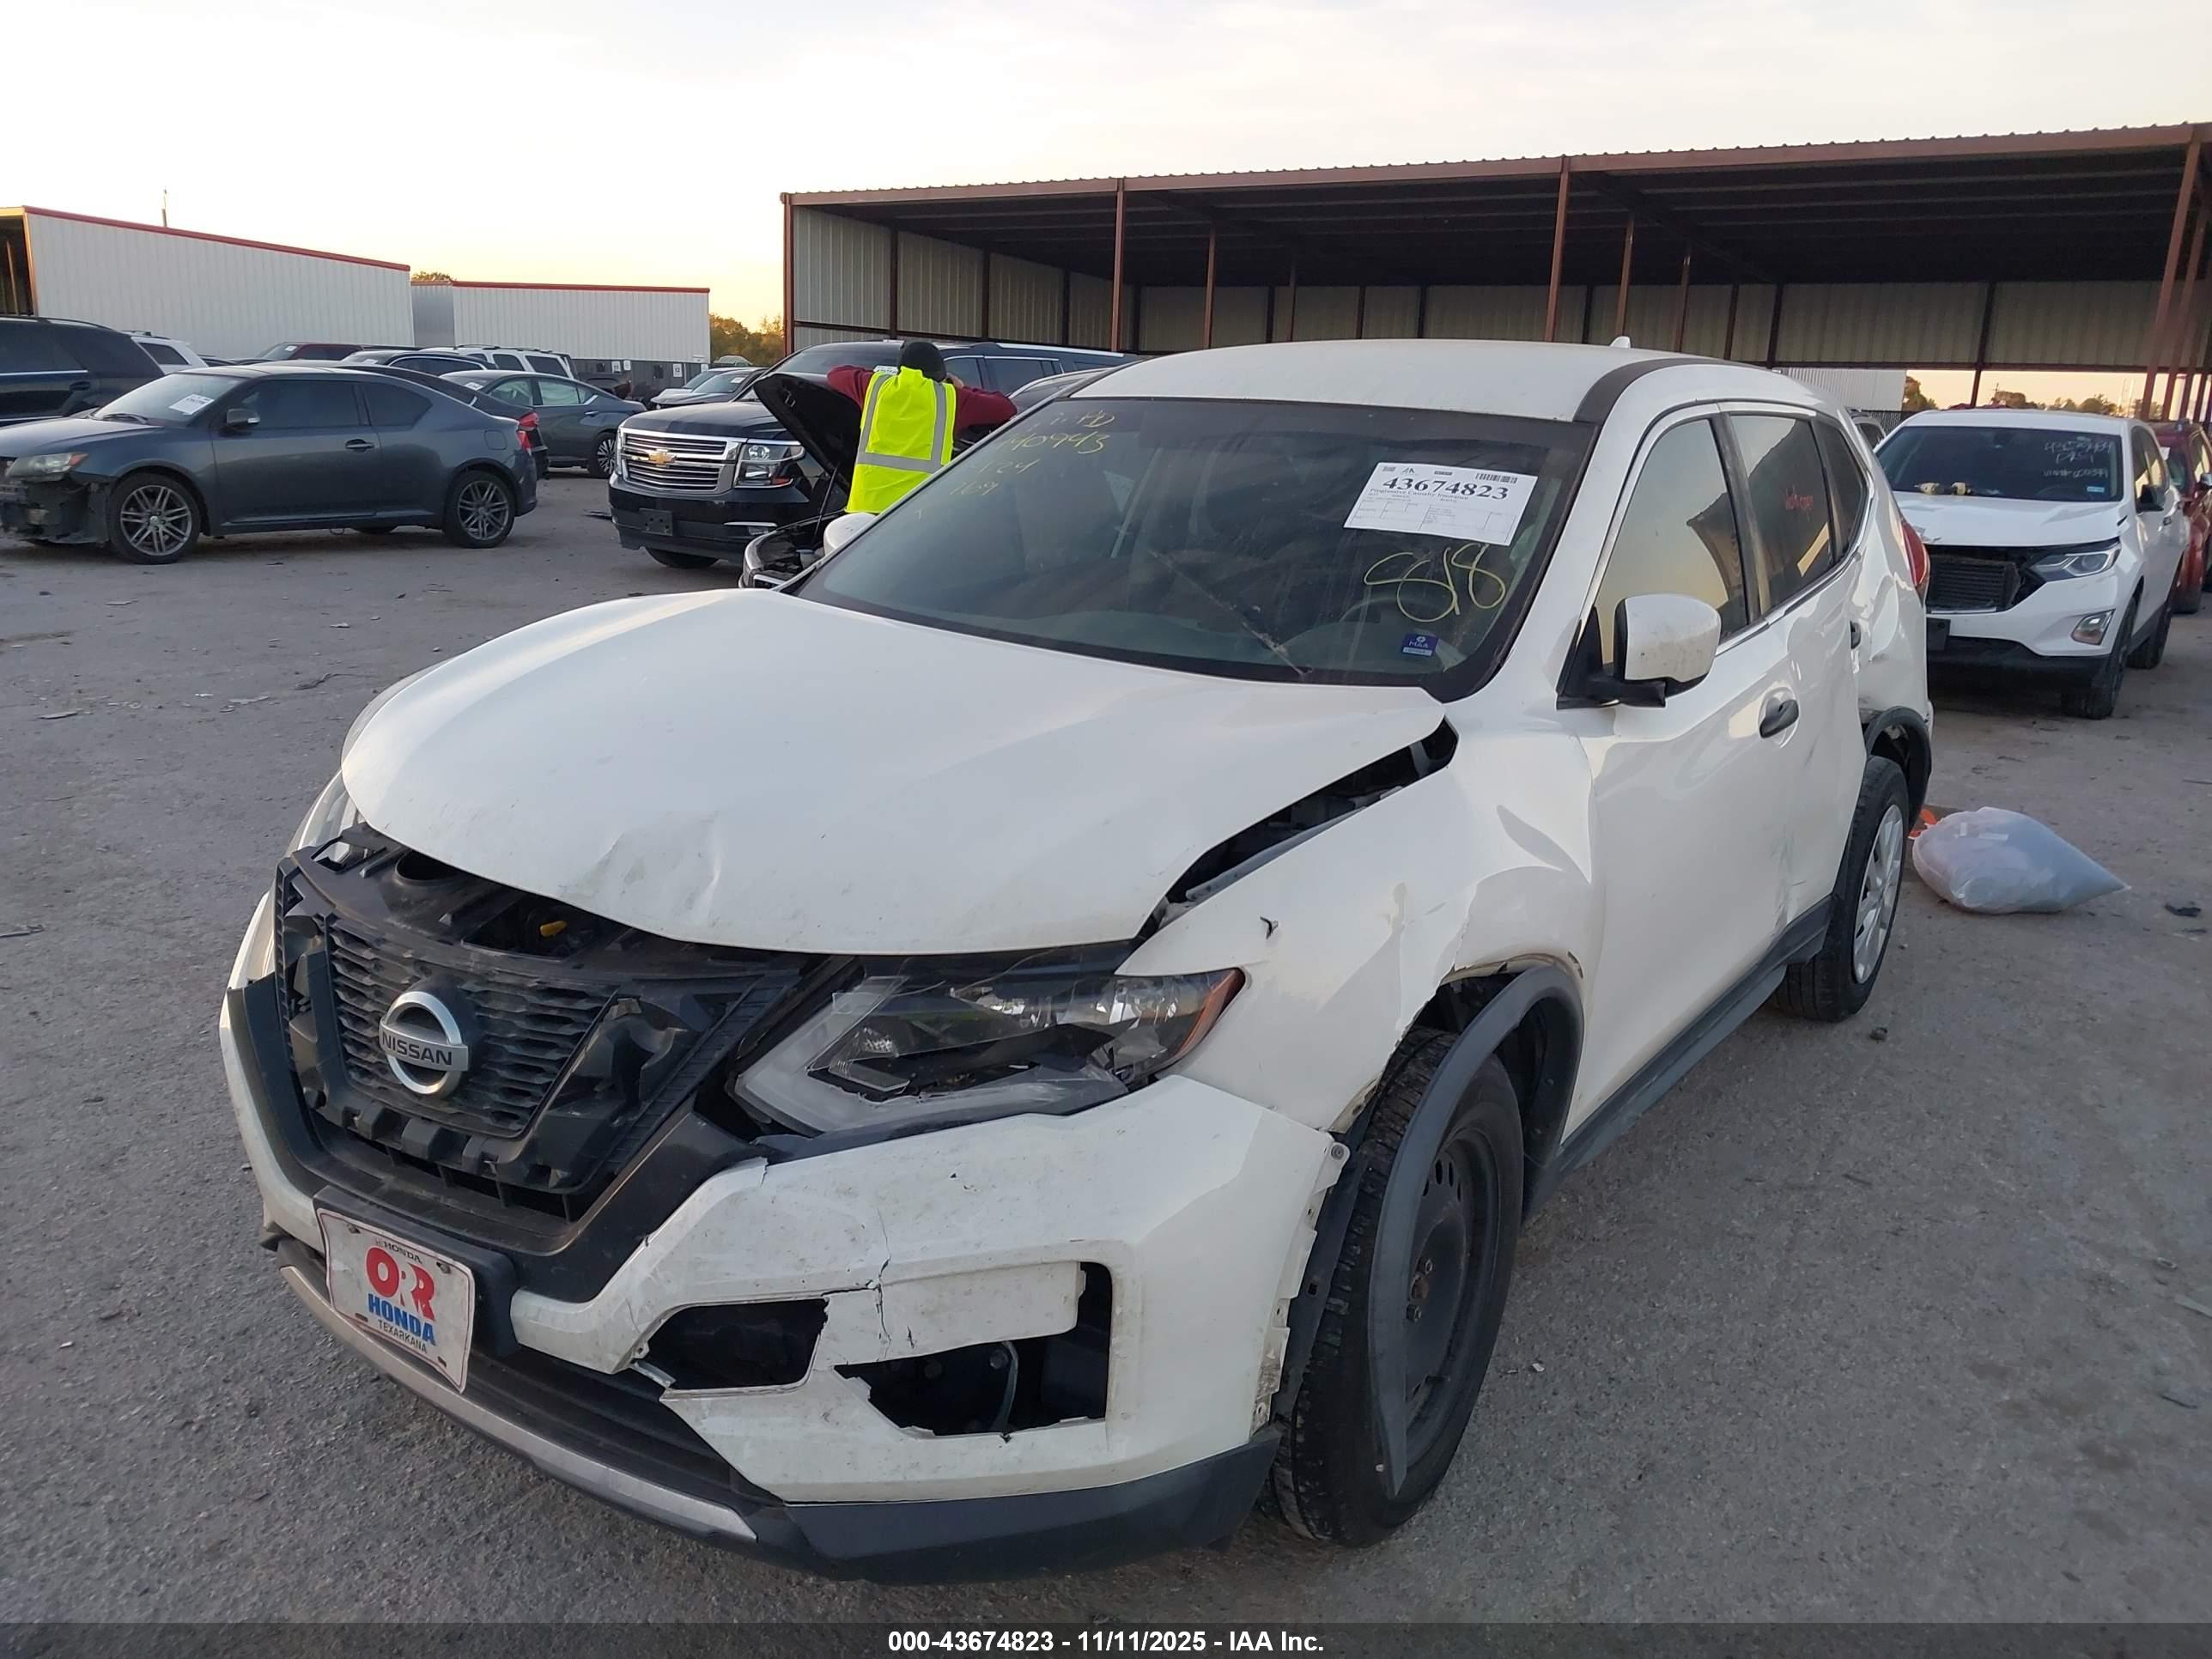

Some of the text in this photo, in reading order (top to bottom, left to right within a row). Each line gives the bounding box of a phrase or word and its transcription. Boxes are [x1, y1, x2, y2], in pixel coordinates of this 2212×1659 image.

[1382, 476, 1509, 501] 43674823
[382, 1030, 453, 1066] NISSAN
[382, 1241, 423, 1265] HONDA
[368, 1292, 436, 1347] HONDA
[378, 1319, 428, 1354] TEXARKANA
